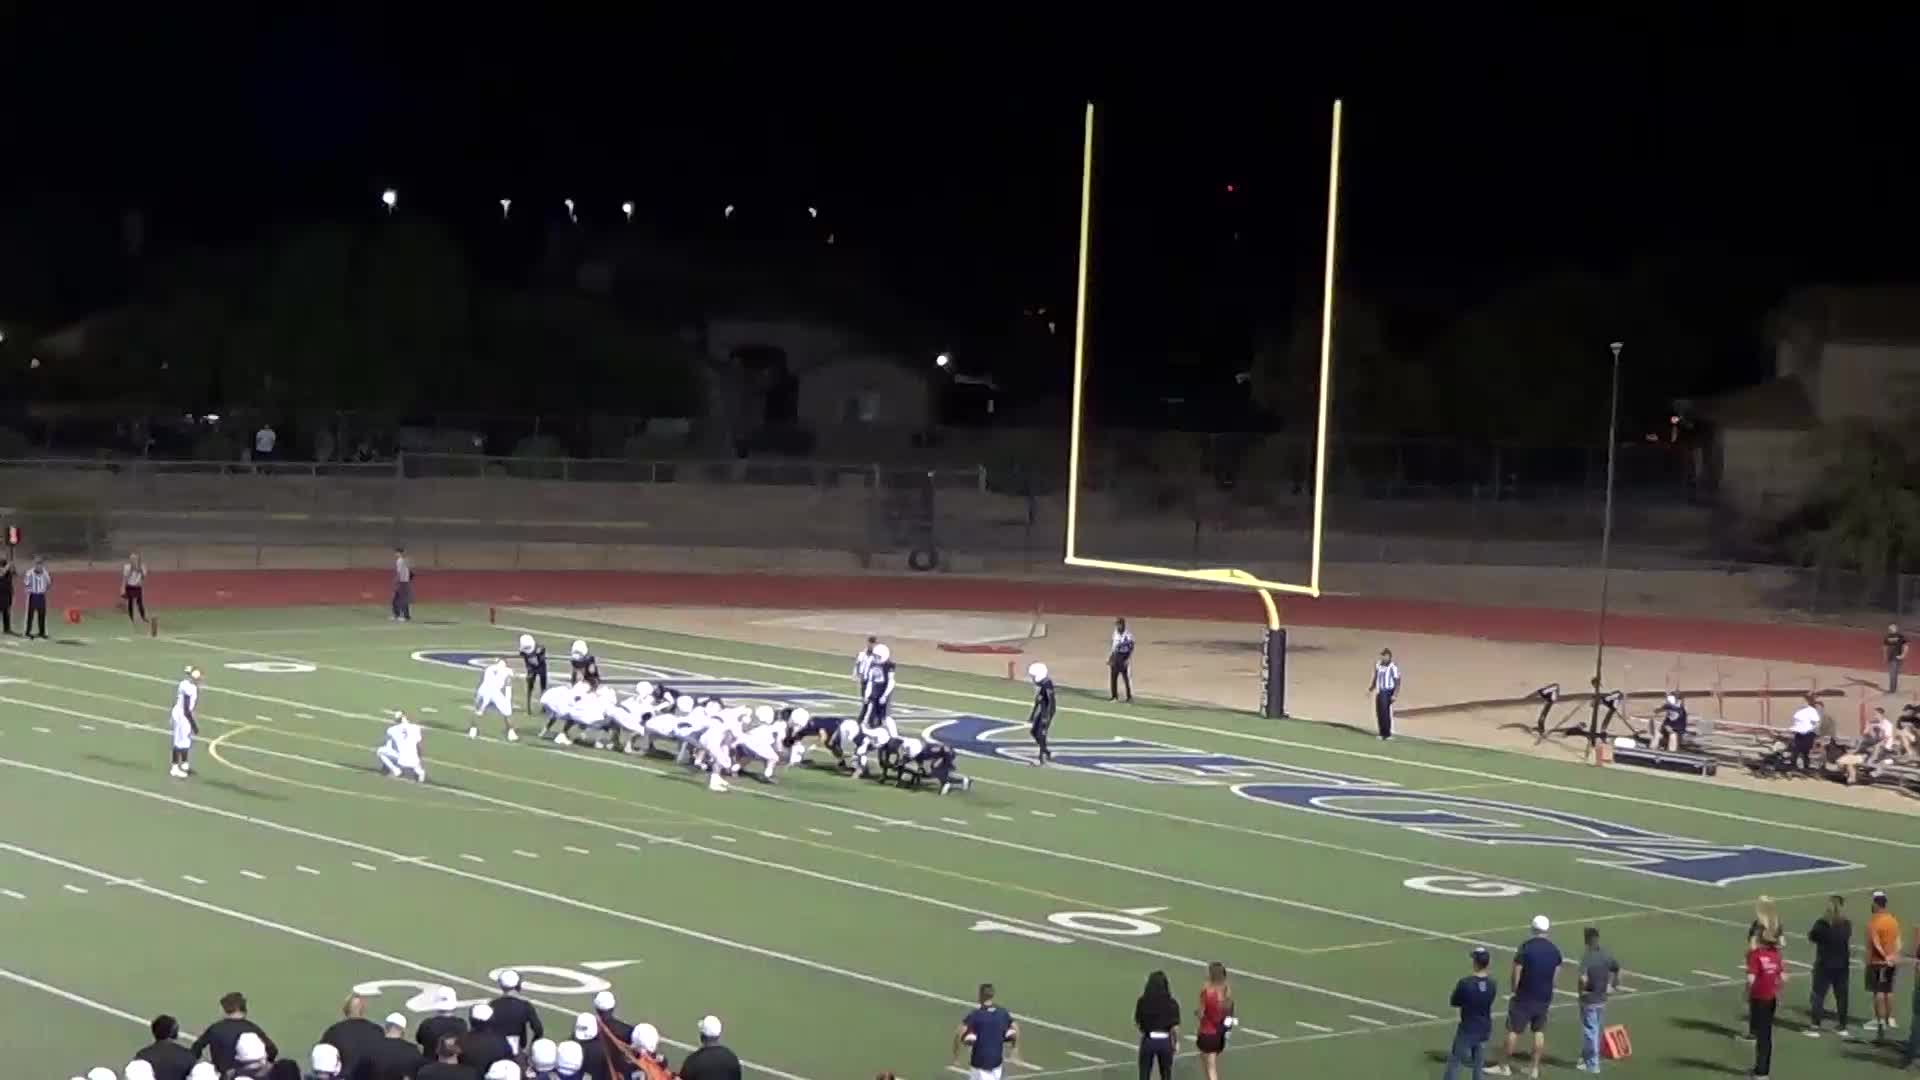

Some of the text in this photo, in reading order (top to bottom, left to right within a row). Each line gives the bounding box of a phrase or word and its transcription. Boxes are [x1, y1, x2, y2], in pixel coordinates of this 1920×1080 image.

[1403, 875, 1534, 897] G
[968, 911, 1163, 944] 10
[353, 965, 612, 1013] 20
[1608, 1030, 1630, 1056] 10
